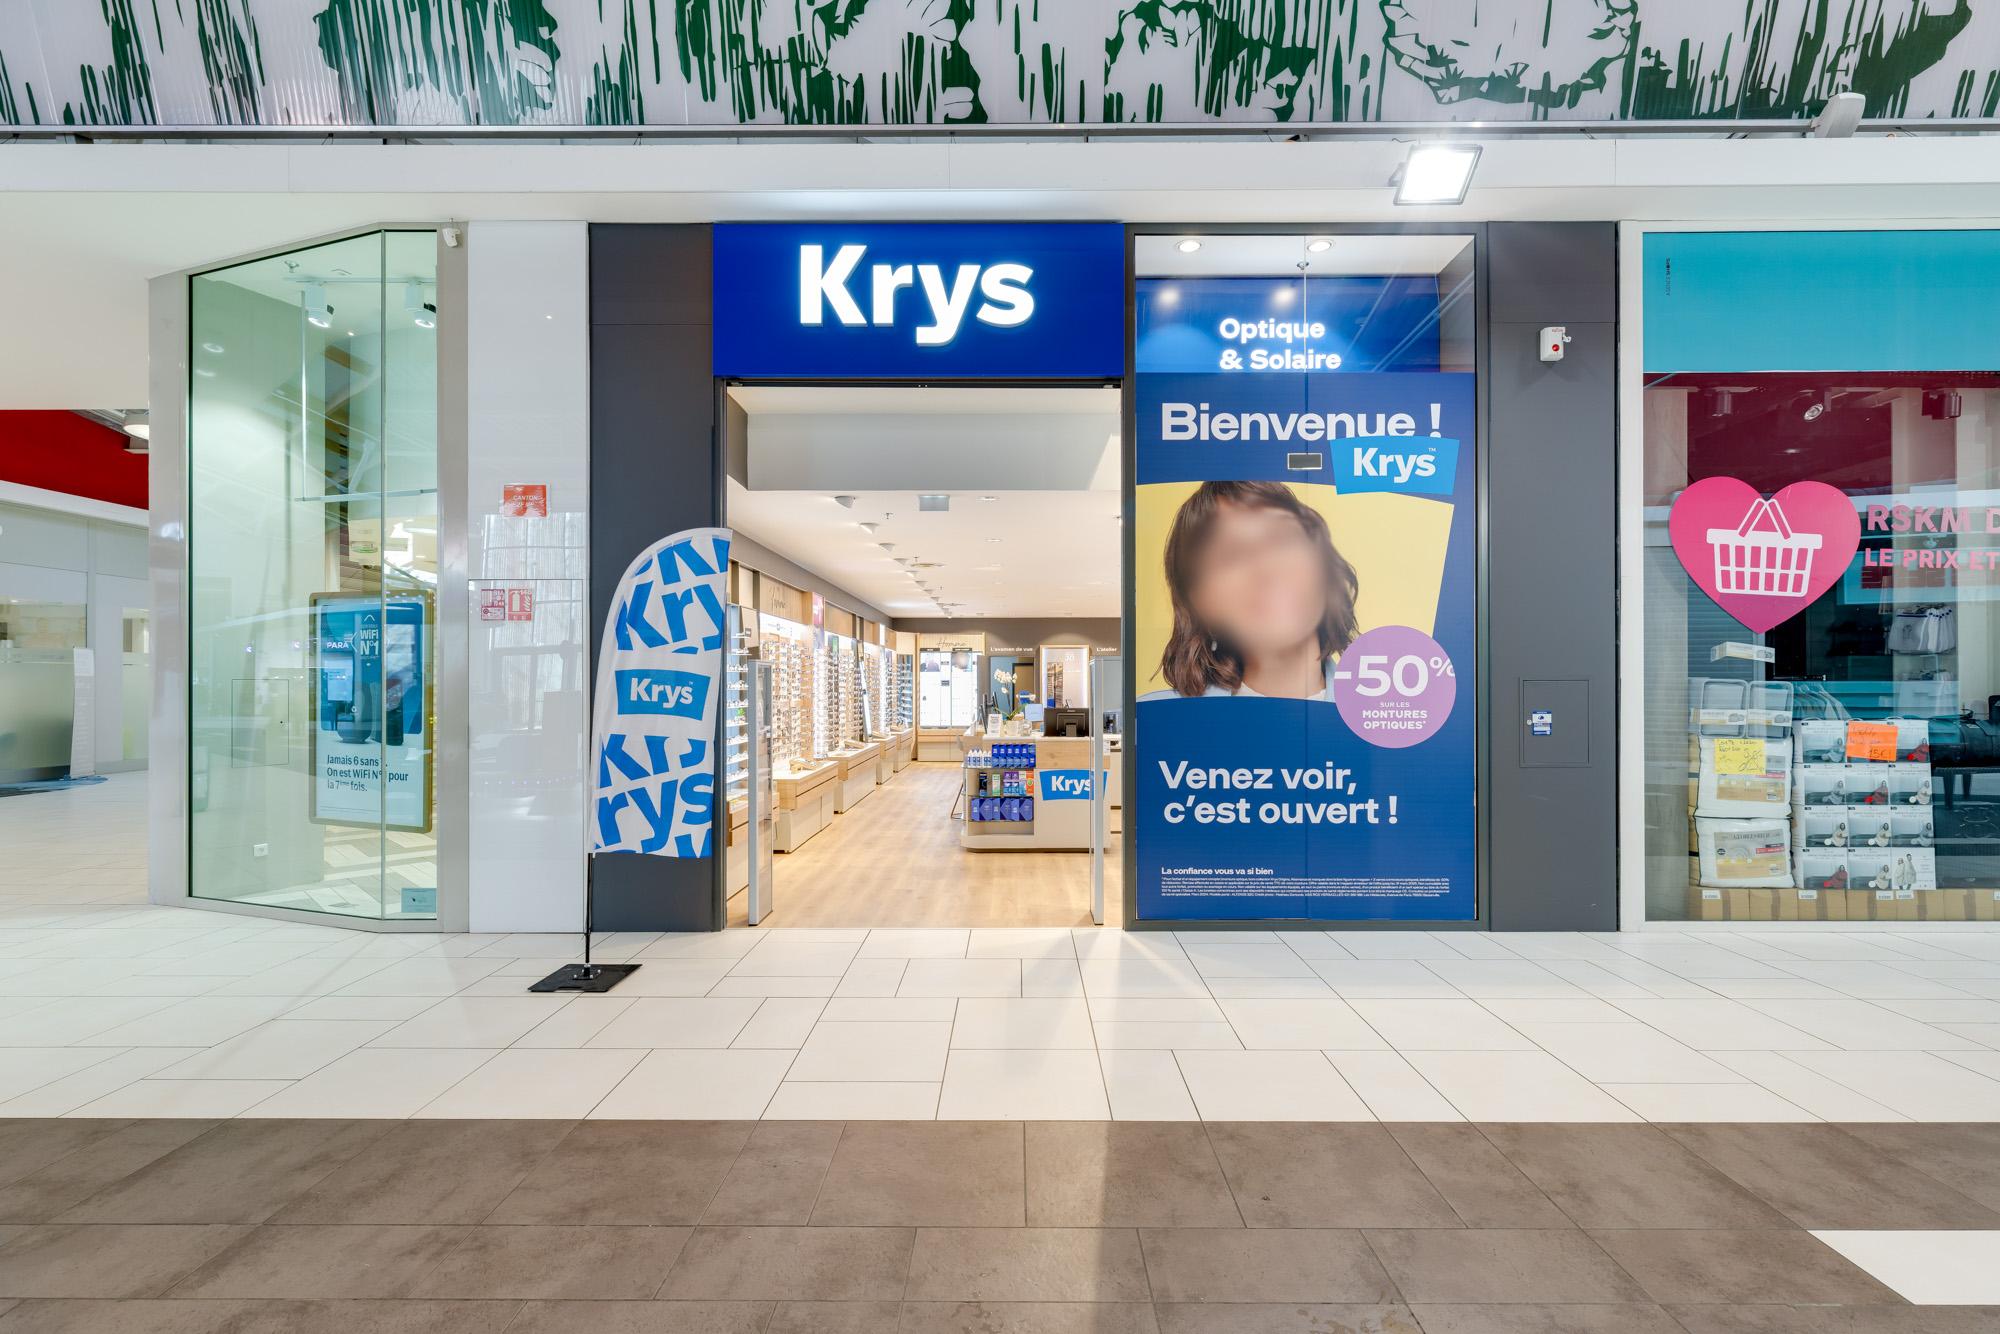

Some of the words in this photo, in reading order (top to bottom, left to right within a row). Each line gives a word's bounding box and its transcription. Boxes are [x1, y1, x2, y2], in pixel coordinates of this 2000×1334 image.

[800, 244, 1035, 346] Krys
[1219, 318, 1325, 344] Optique
[1219, 349, 1242, 370] &
[1250, 349, 1341, 370] Solaire
[1161, 402, 1416, 441] Bienvenue
[1353, 447, 1436, 484] Krys
[1867, 504, 1971, 533] RSKM
[1865, 547, 1894, 567] LE
[1903, 549, 1960, 569] PRIX
[1969, 550, 2000, 571] ET
[1333, 654, 1456, 697] -50%
[630, 677, 693, 709] Krys
[1362, 710, 1428, 719] MONTURES
[327, 754, 353, 766] Jamais
[353, 755, 359, 766] 6
[360, 757, 380, 767] sans
[327, 767, 338, 777] On
[340, 768, 351, 778] est
[388, 771, 409, 782] pour
[350, 780, 368, 791] fois.
[1158, 760, 1273, 790] Venez
[1280, 761, 1357, 795] voir,
[1163, 795, 1251, 824] c'est
[1259, 798, 1379, 824] ouvert
[1388, 795, 1398, 824] !
[1161, 866, 1172, 875] La
[1173, 866, 1213, 875] confiance
[1214, 867, 1234, 875] vous
[1246, 866, 1254, 875] si
[1255, 866, 1274, 875] bien
